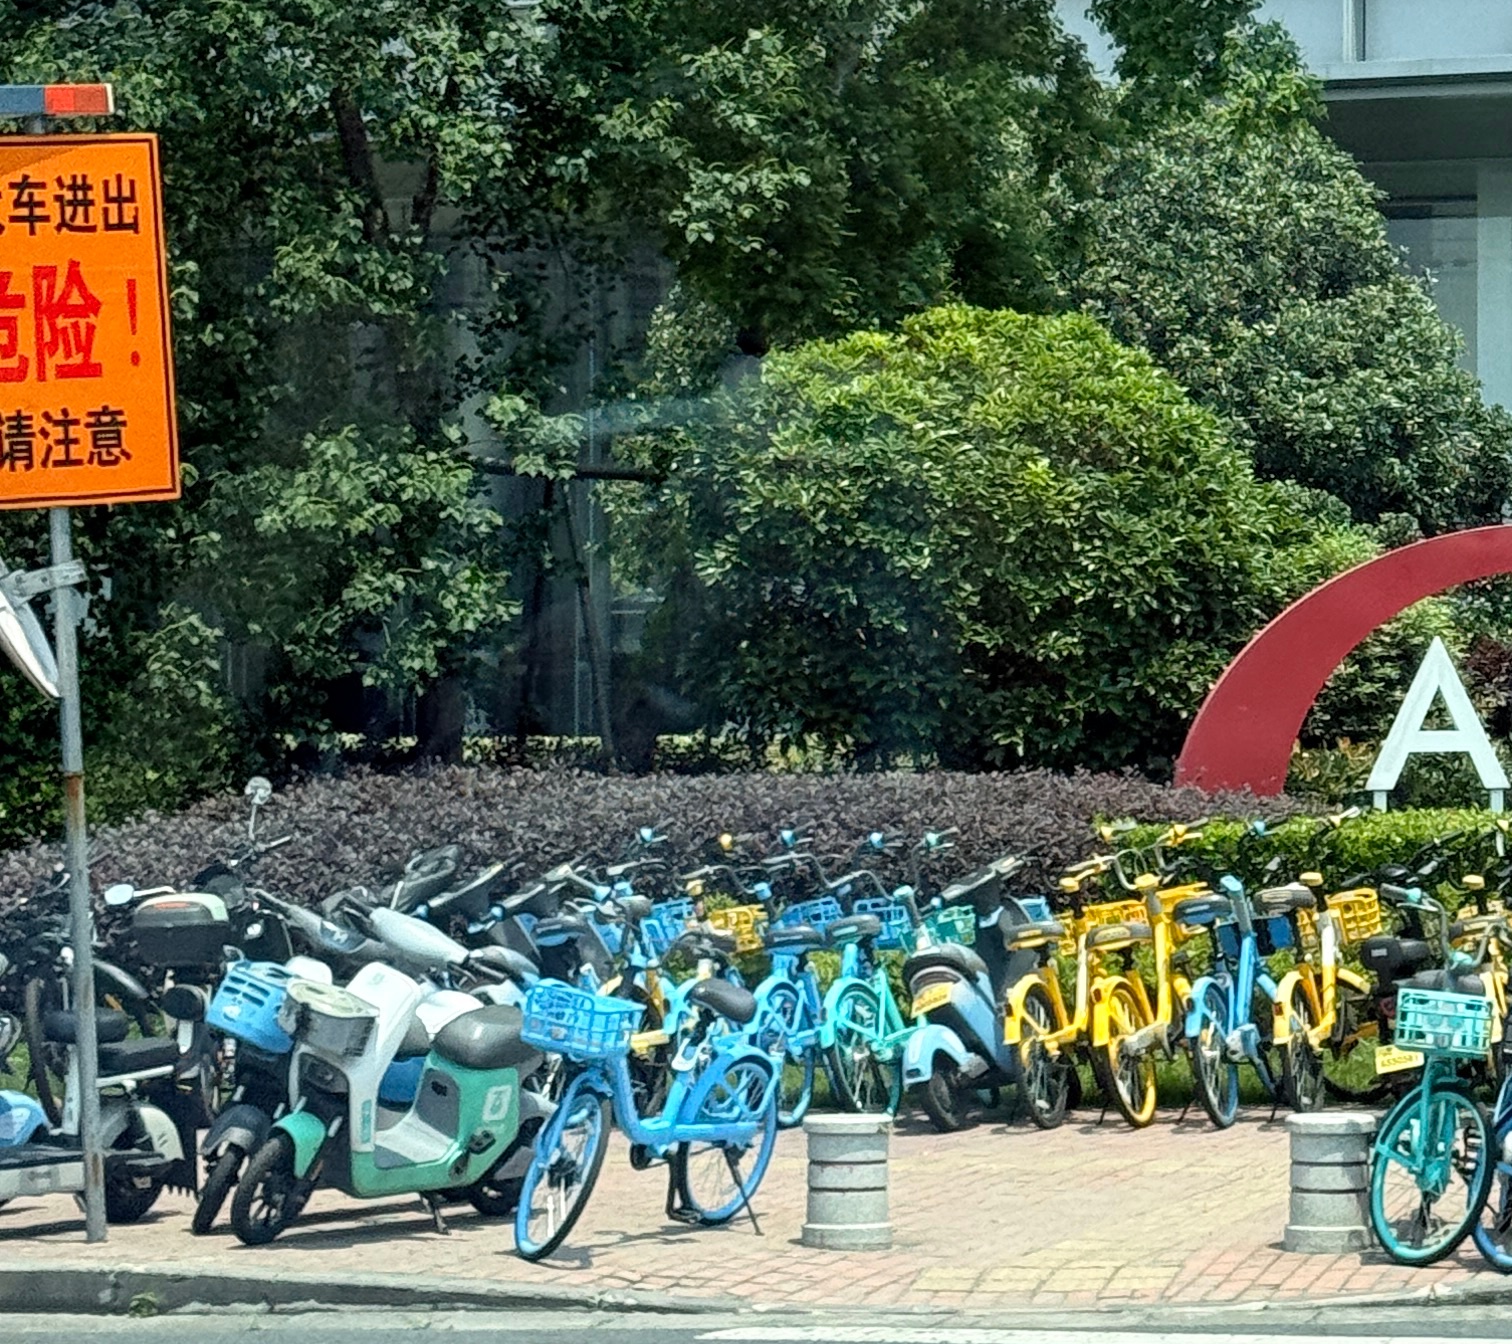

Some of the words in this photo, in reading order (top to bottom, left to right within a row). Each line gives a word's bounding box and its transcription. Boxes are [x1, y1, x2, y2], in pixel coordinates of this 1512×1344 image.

[0, 173, 140, 236] 车进出
[0, 405, 132, 472] 请注意
